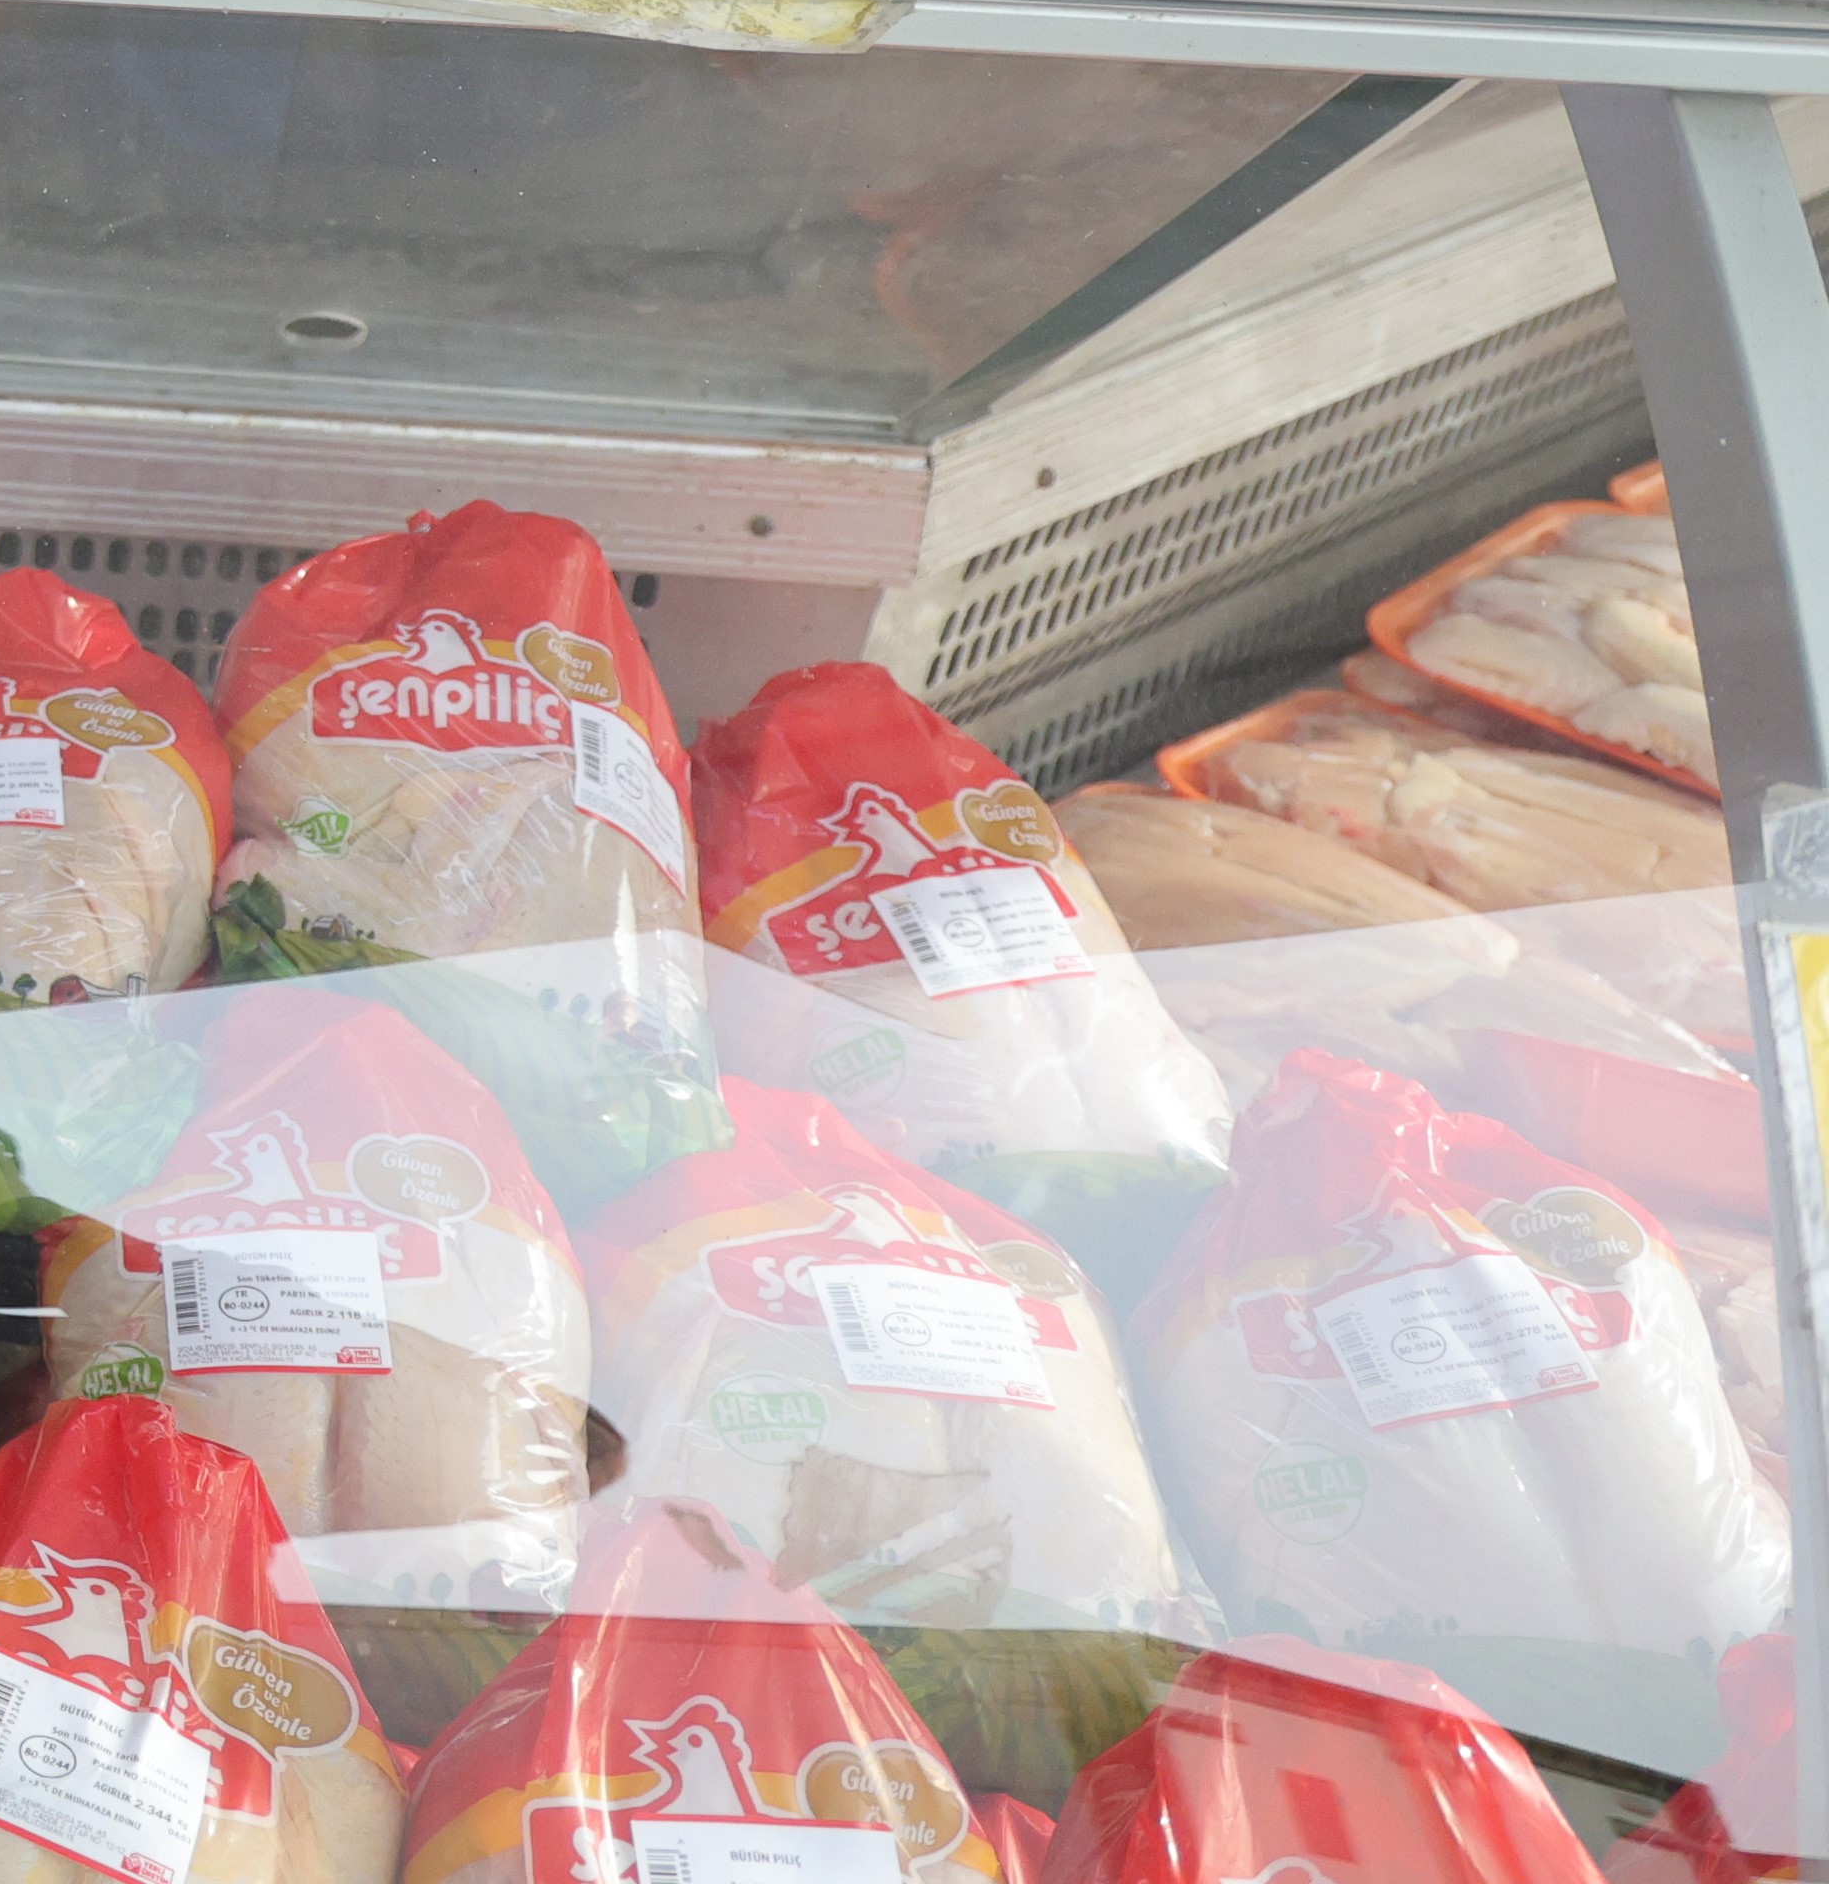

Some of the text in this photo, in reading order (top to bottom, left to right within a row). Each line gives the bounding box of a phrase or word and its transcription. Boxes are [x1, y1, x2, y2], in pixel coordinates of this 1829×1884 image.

[338, 672, 564, 740] şenpiliç
[382, 1149, 443, 1177] Güven
[401, 1177, 462, 1211] Özenle
[1509, 1207, 1593, 1240] Güven
[1548, 1235, 1631, 1269] Özenle
[235, 1290, 248, 1298] TR
[1404, 1331, 1419, 1341] TR
[85, 1361, 157, 1398] HELAL
[715, 1395, 823, 1430] HELAL
[1257, 1460, 1362, 1508] HELAL
[214, 1645, 293, 1696] Güven
[6, 1689, 27, 1725] 023444
[232, 1682, 314, 1742] Özenle
[264, 1687, 282, 1708] ve
[59, 1703, 126, 1738] BÜTÜN PİLİÇ
[42, 1740, 57, 1753] TR
[51, 1726, 70, 1739] Son
[73, 1732, 112, 1756] Tüketim
[24, 1747, 70, 1771] 80-0244
[124, 1769, 138, 1781] NO
[51, 1787, 63, 1798] DE
[64, 1792, 112, 1820] MUHAFAZA
[134, 1799, 172, 1823] 2.344
[730, 1850, 802, 1868] BÜTÜN PİLİÇ
